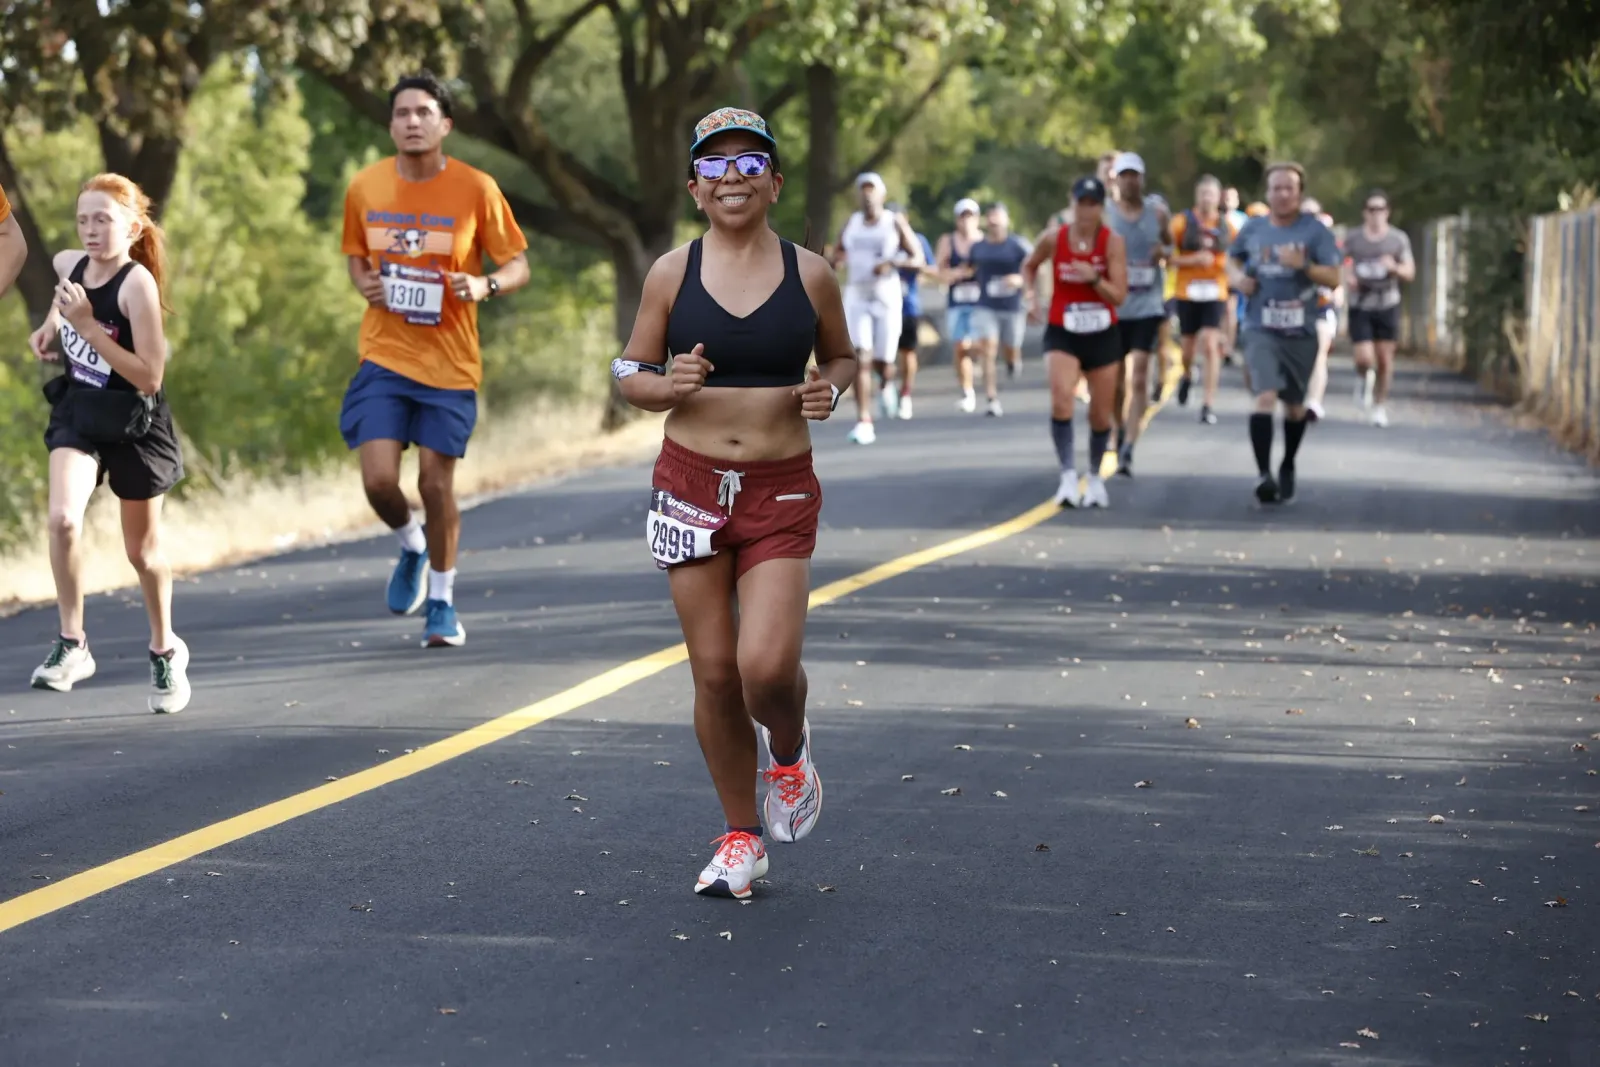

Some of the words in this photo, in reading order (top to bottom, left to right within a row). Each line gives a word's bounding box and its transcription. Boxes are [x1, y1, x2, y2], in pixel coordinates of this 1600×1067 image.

[420, 213, 456, 228] Cow
[390, 284, 426, 307] 1310
[63, 324, 99, 366] 3278
[667, 497, 699, 517] Urban
[698, 512, 720, 524] Cow
[652, 519, 696, 560] 2999
